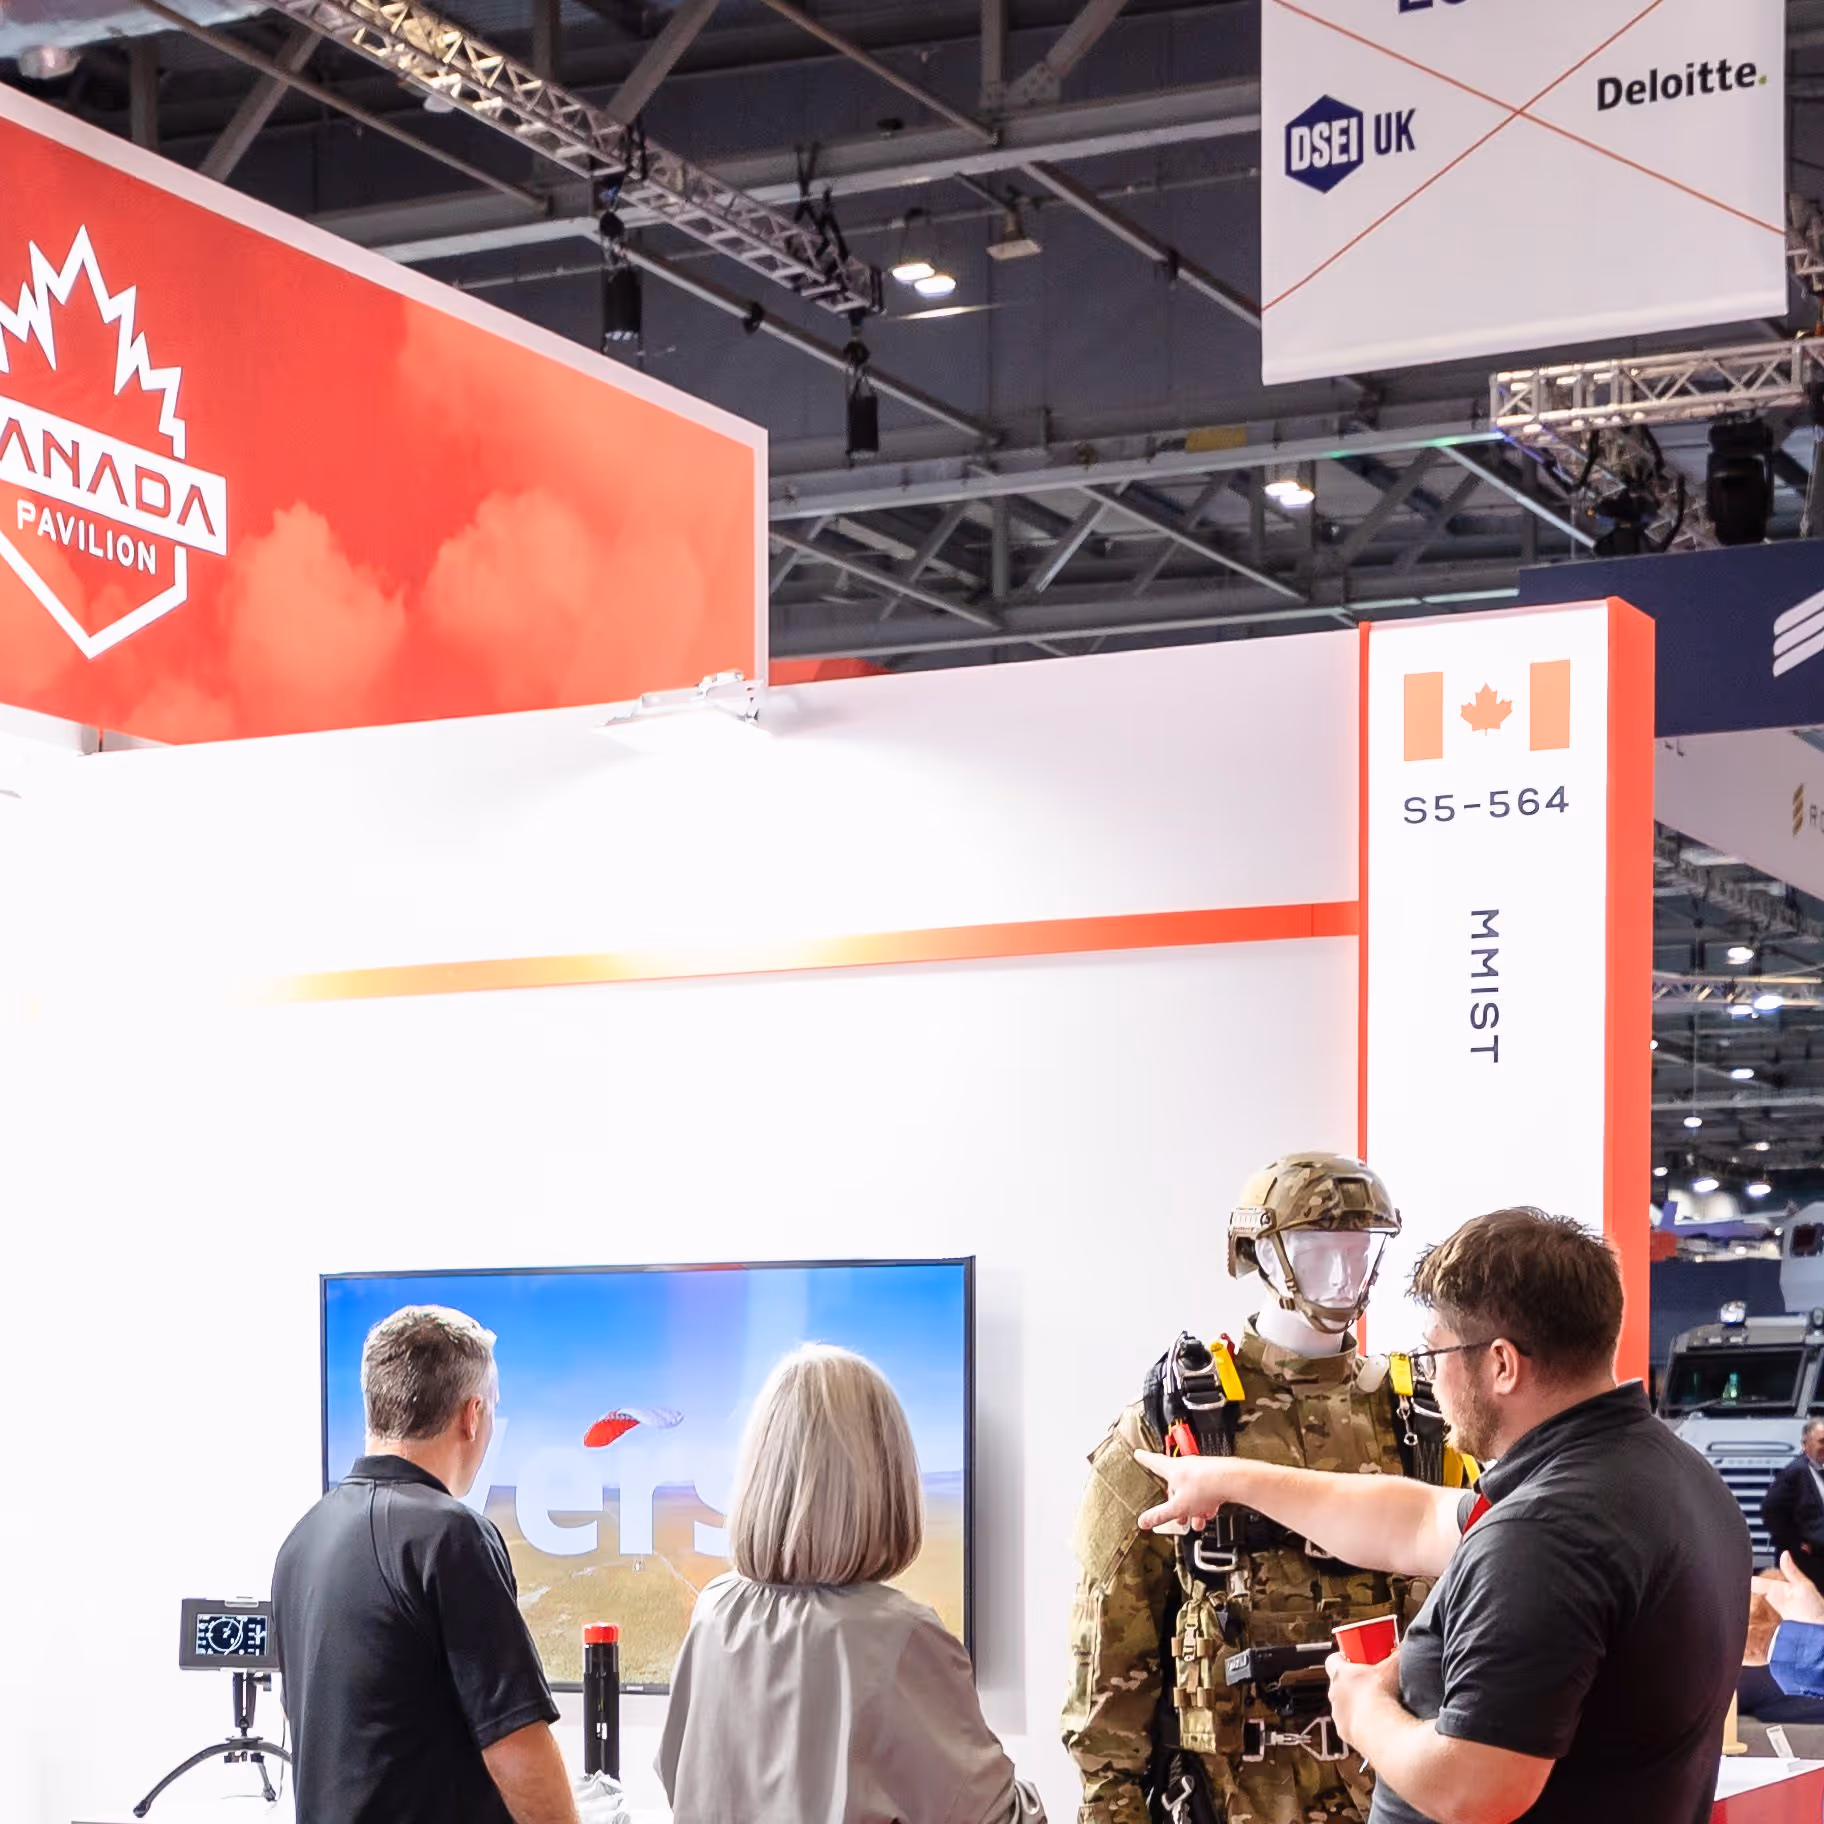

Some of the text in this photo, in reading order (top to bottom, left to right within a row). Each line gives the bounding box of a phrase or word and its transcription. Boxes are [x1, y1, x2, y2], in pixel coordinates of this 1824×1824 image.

[1597, 57, 1768, 111] Deloitte.
[1290, 108, 1417, 171] DSEI UK
[16, 499, 157, 576] PAVILION
[1403, 785, 1570, 824] S5-564
[1470, 908, 1500, 1064] MMIST
